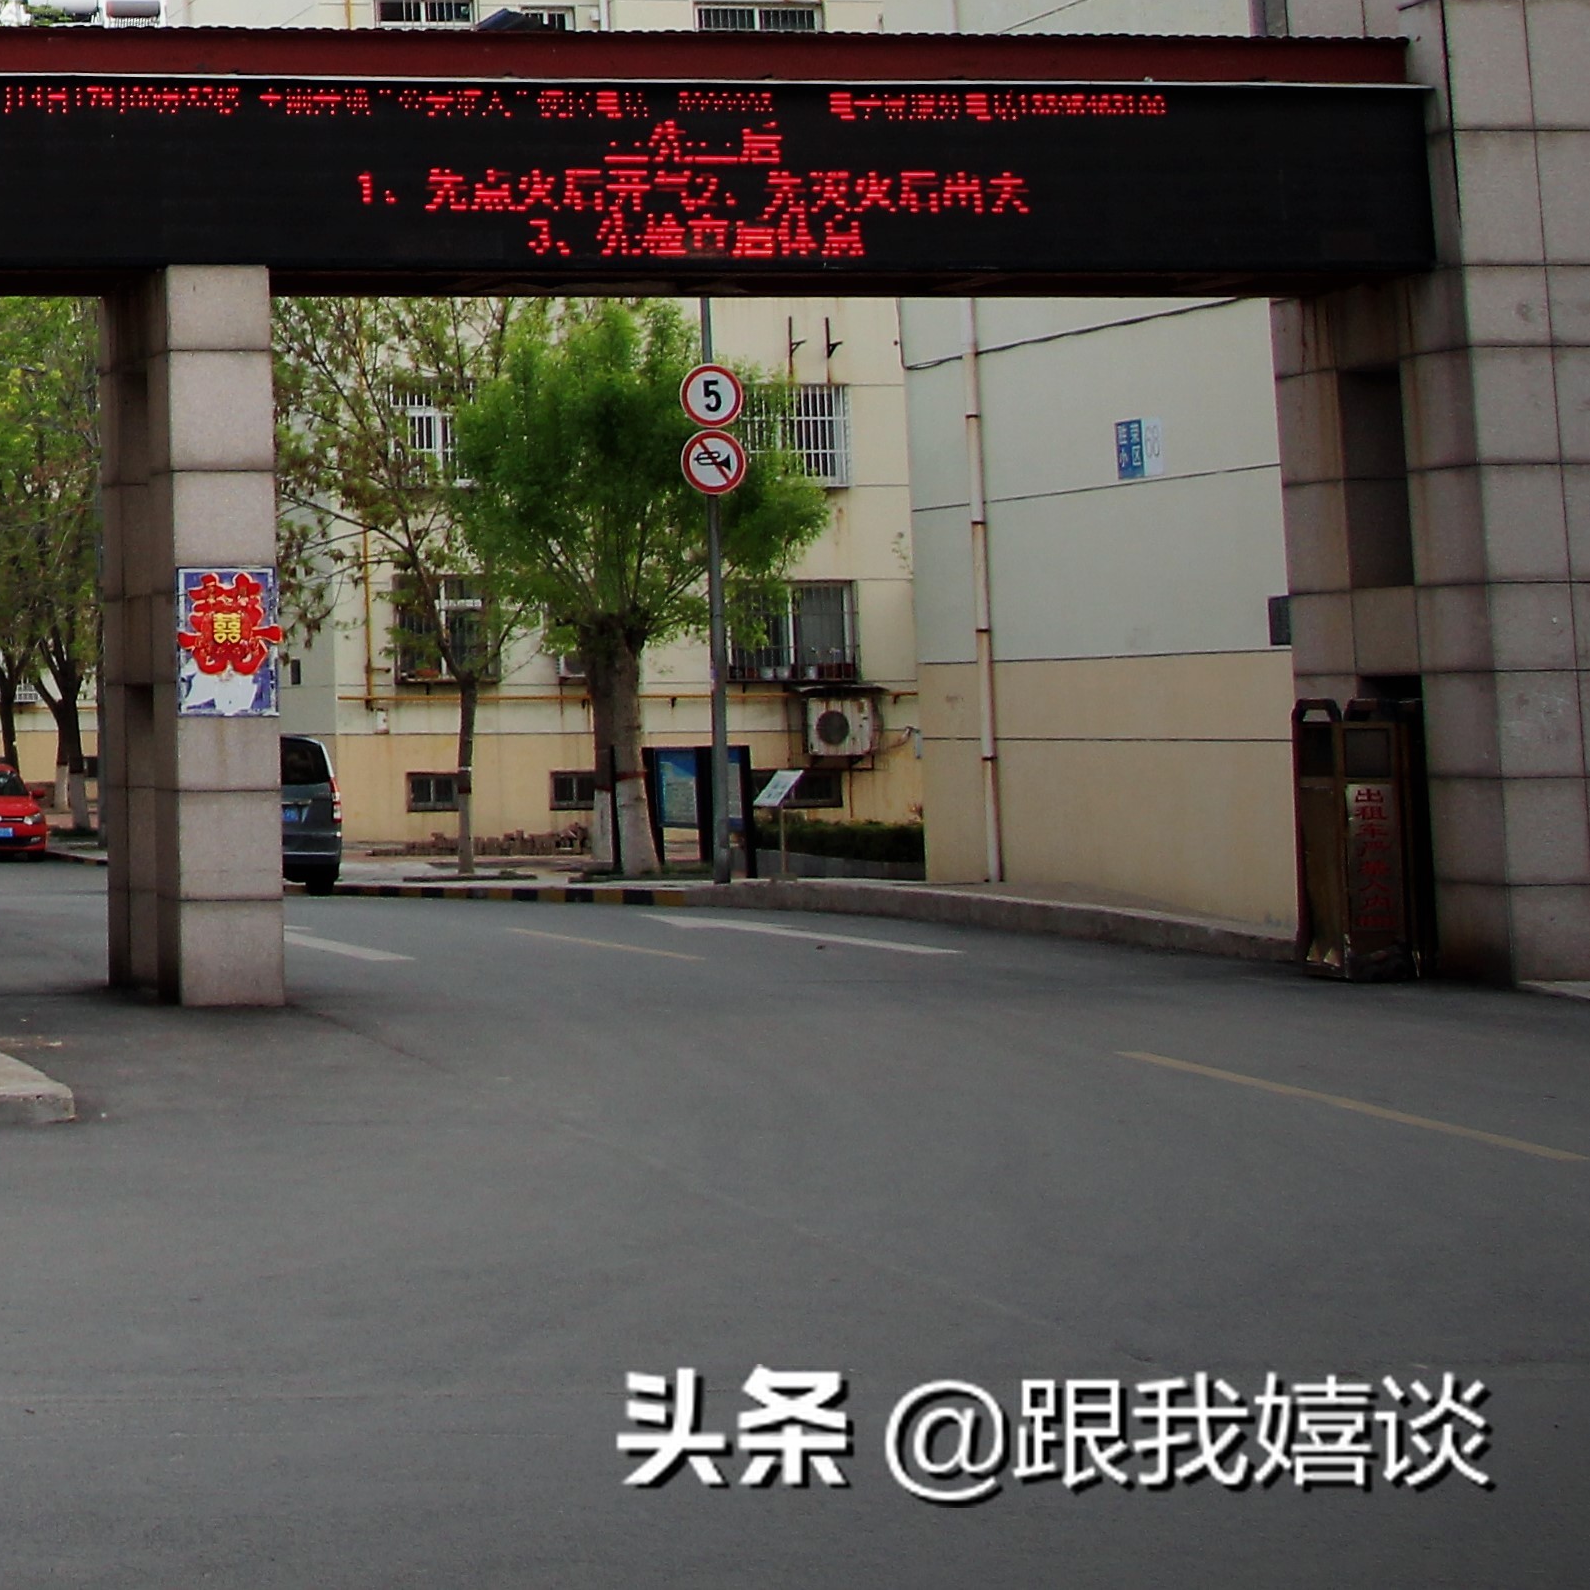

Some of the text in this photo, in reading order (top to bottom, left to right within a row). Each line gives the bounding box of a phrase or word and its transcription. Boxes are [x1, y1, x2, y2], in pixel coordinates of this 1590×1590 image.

[703, 379, 722, 413] 5
[1355, 788, 1398, 928] 出租车严禁入内
